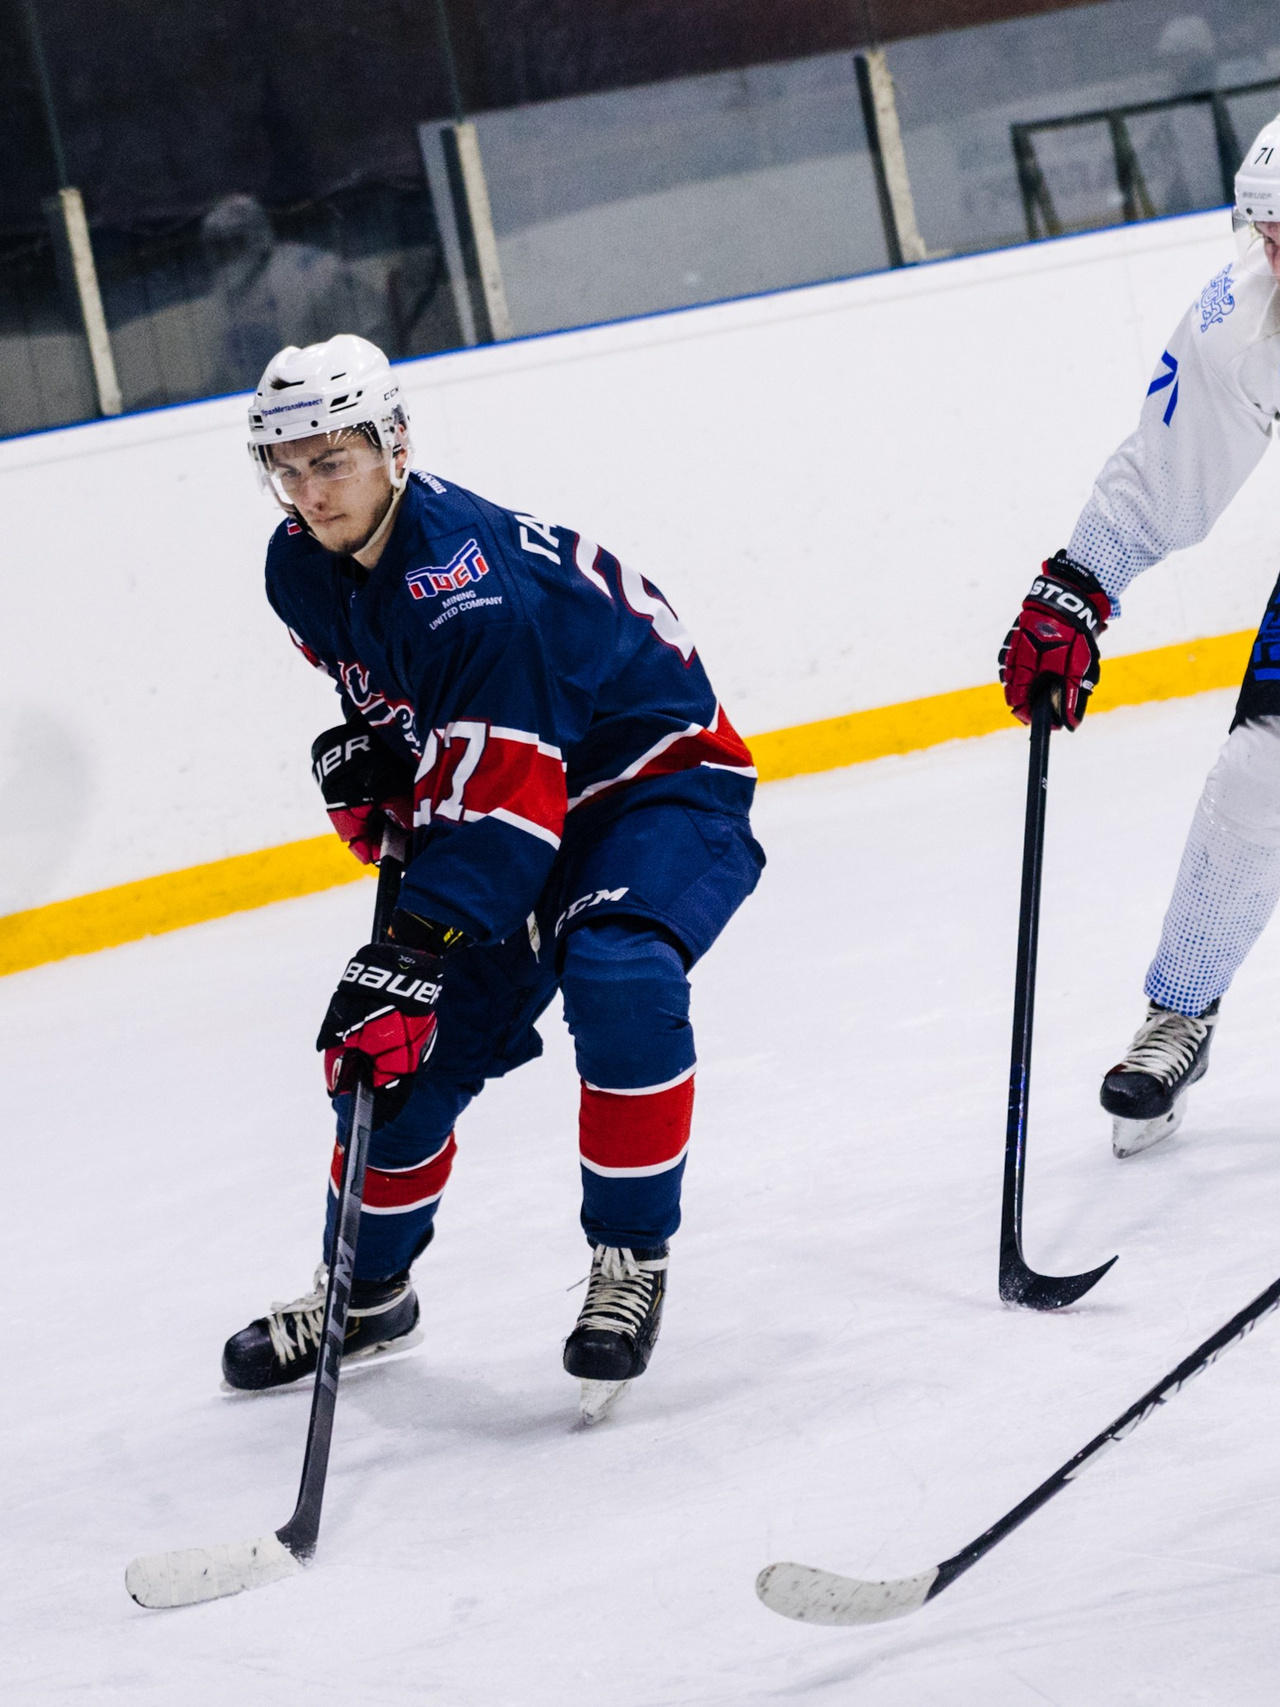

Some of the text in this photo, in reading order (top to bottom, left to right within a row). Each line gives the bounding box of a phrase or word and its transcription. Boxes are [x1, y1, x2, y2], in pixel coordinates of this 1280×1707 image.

[1254, 147, 1274, 165] 71
[428, 595, 503, 631] UNITED COMPANY
[441, 589, 477, 610] MINING
[1029, 580, 1098, 631] STON
